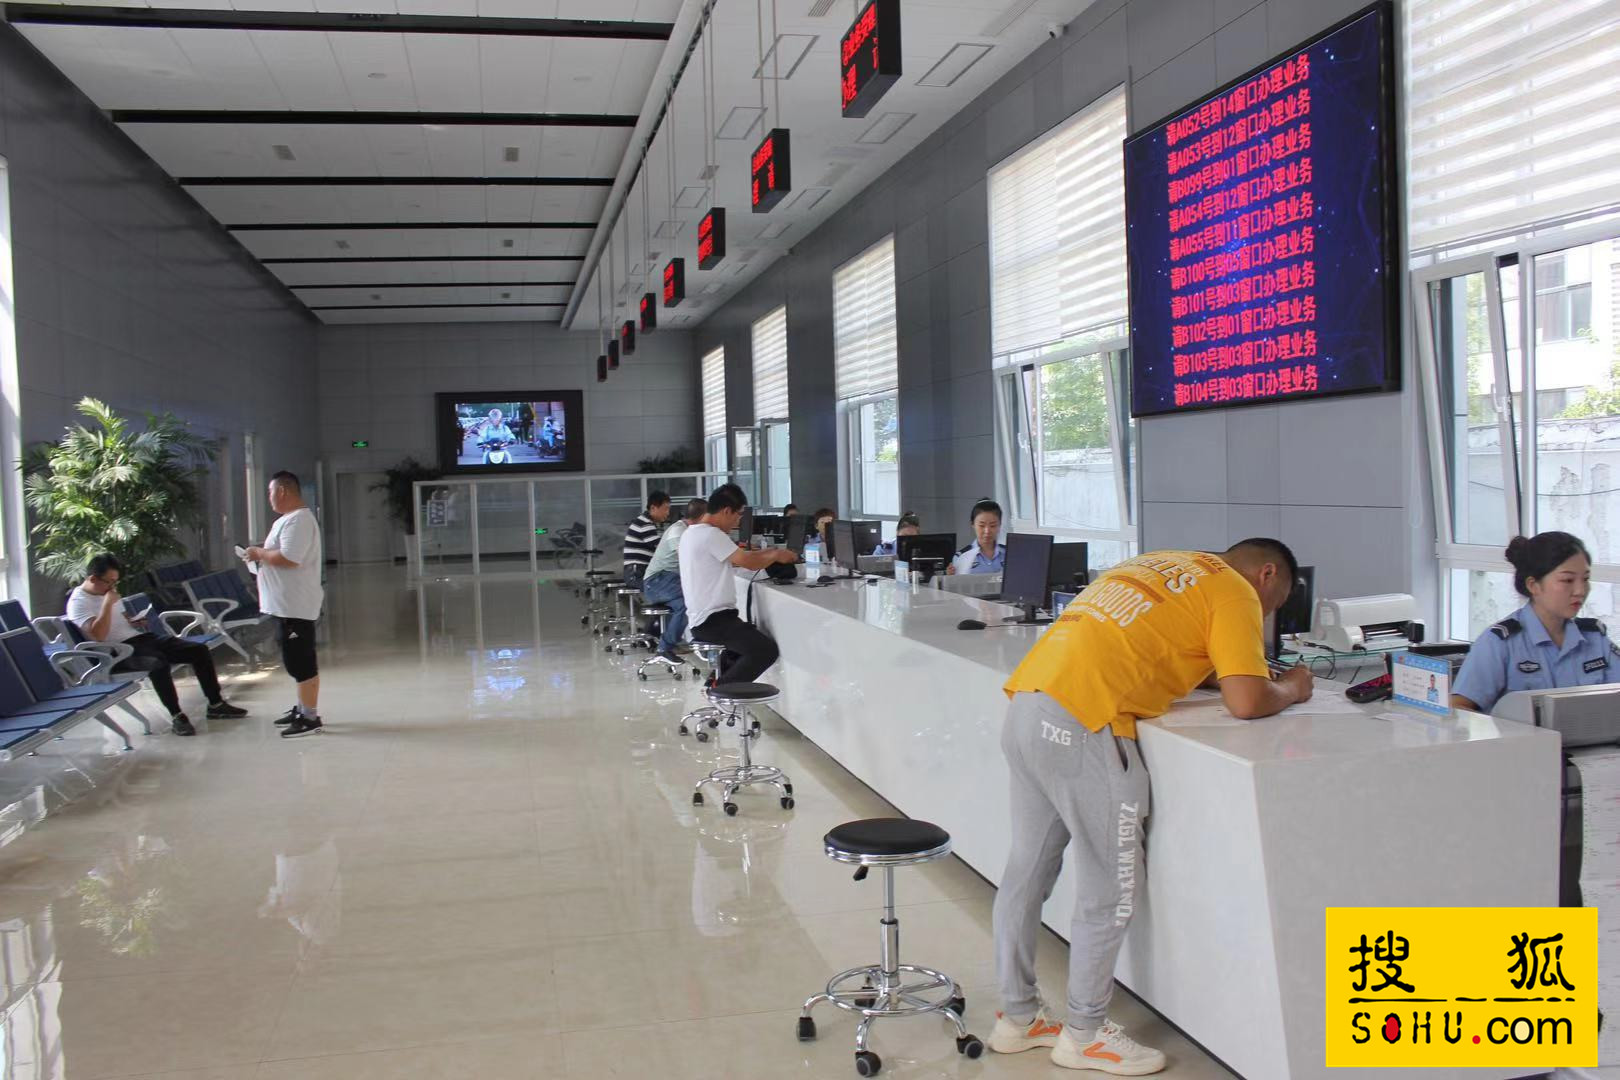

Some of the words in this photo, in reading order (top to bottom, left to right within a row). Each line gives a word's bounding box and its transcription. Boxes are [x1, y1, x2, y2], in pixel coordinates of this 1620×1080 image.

[1166, 54, 1310, 146] 请A052号到14窗口办理业务
[1167, 88, 1311, 175] 请A053号到12窗口办理业务
[1167, 122, 1312, 204] 请B099号到01窗口办理业务
[1171, 260, 1316, 319] 请B101号到03窗口办理业务
[1172, 295, 1317, 348] 请B102号到01窗口办理业务
[1173, 329, 1317, 377] 请B103号到03窗口办理业务
[1174, 364, 1318, 406] 请B104号到03窗口办理业务
[1041, 719, 1072, 746] TXG
